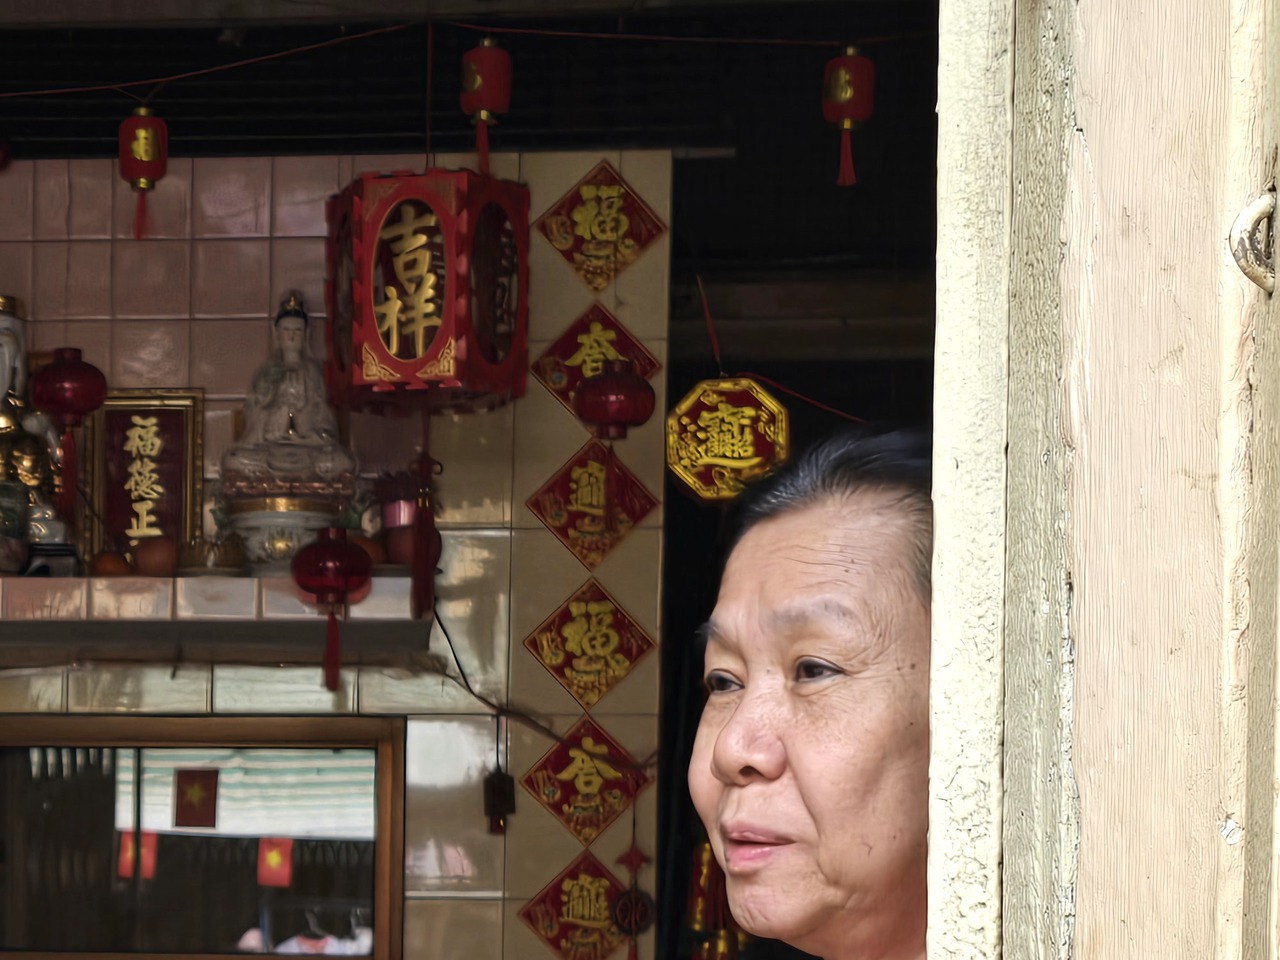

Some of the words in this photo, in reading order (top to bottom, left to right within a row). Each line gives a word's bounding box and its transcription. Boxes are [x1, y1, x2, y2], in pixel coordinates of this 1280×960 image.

[571, 184, 629, 241] 福
[373, 203, 442, 359] 吉祥
[123, 415, 165, 563] 福德正
[561, 601, 619, 657] 福
